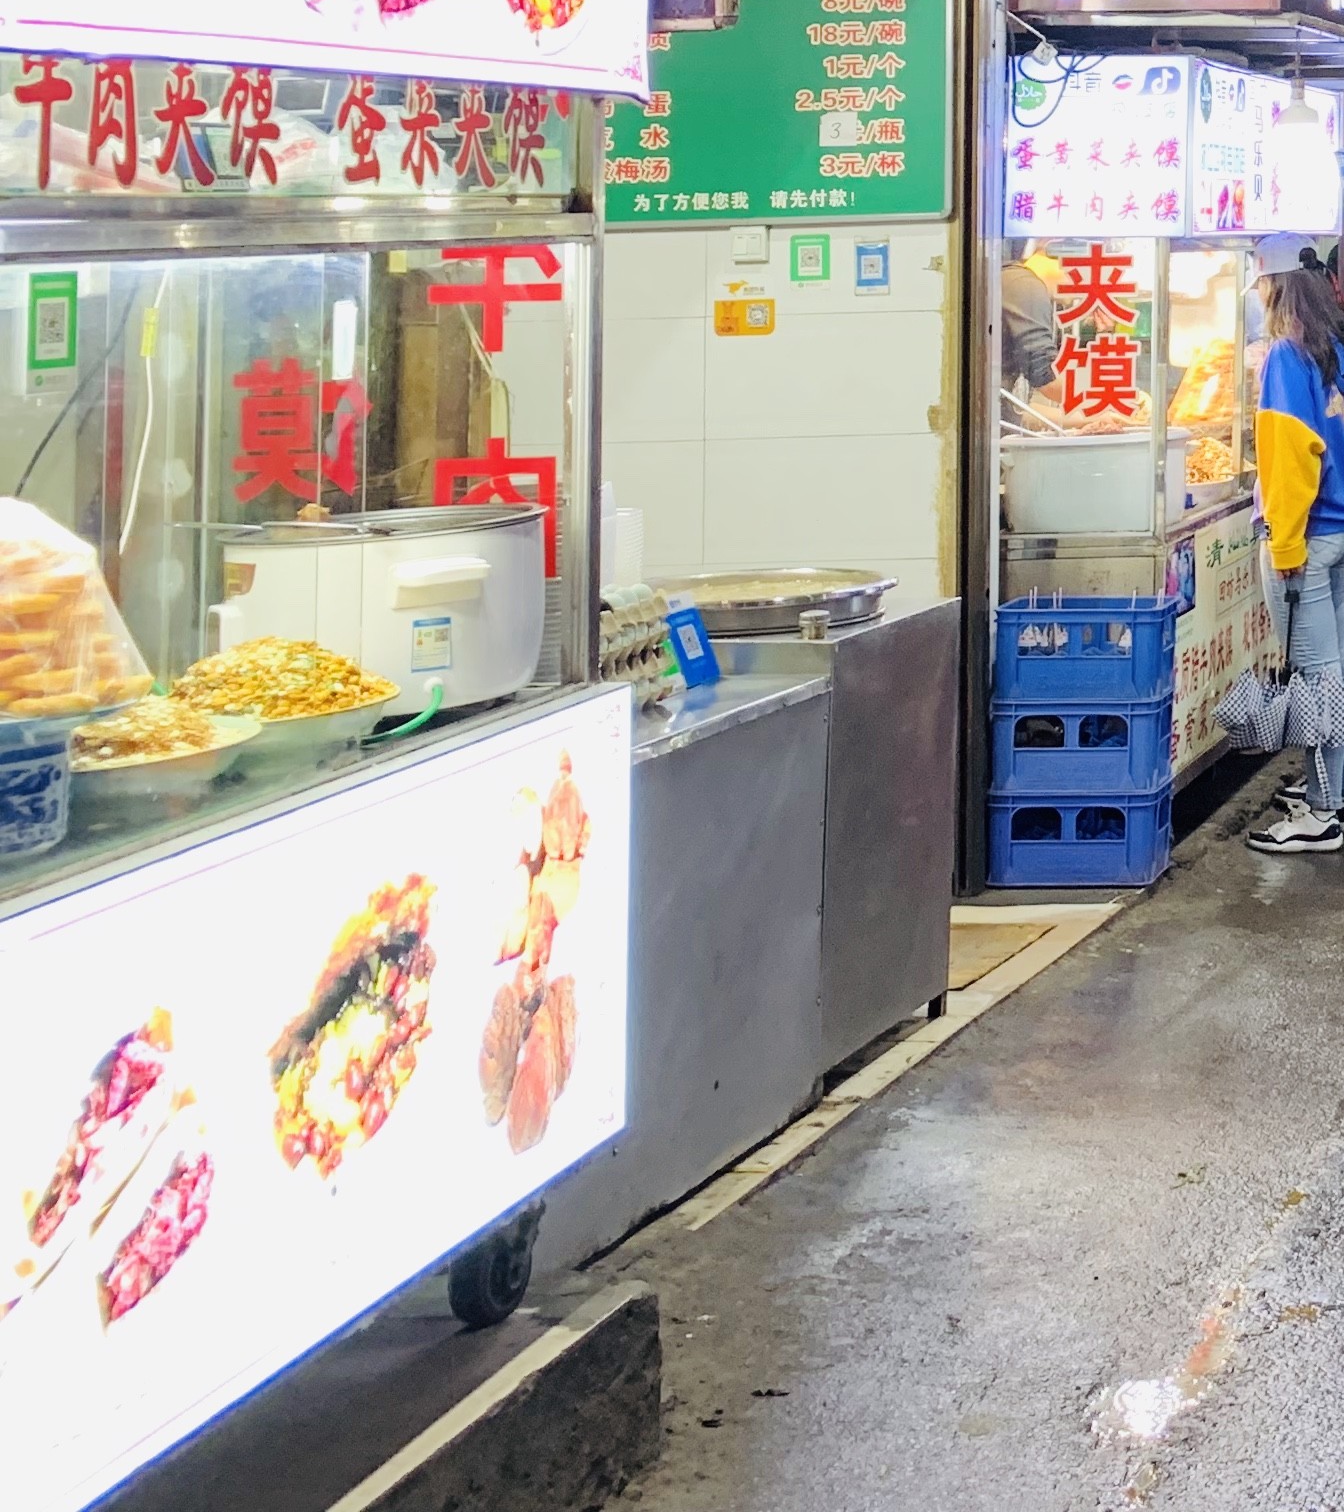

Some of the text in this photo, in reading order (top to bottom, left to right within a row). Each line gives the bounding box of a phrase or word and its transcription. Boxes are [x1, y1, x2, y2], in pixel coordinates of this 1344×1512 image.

[806, 19, 907, 45] 18元/碗
[822, 52, 906, 79] 1元/个
[794, 86, 906, 113] 2.5元/个
[818, 151, 905, 179] 3元/杯
[633, 191, 750, 213] 为了方便您我
[1008, 188, 1181, 224] 腊牛肉夹馍
[1055, 241, 1140, 419] 夹馍
